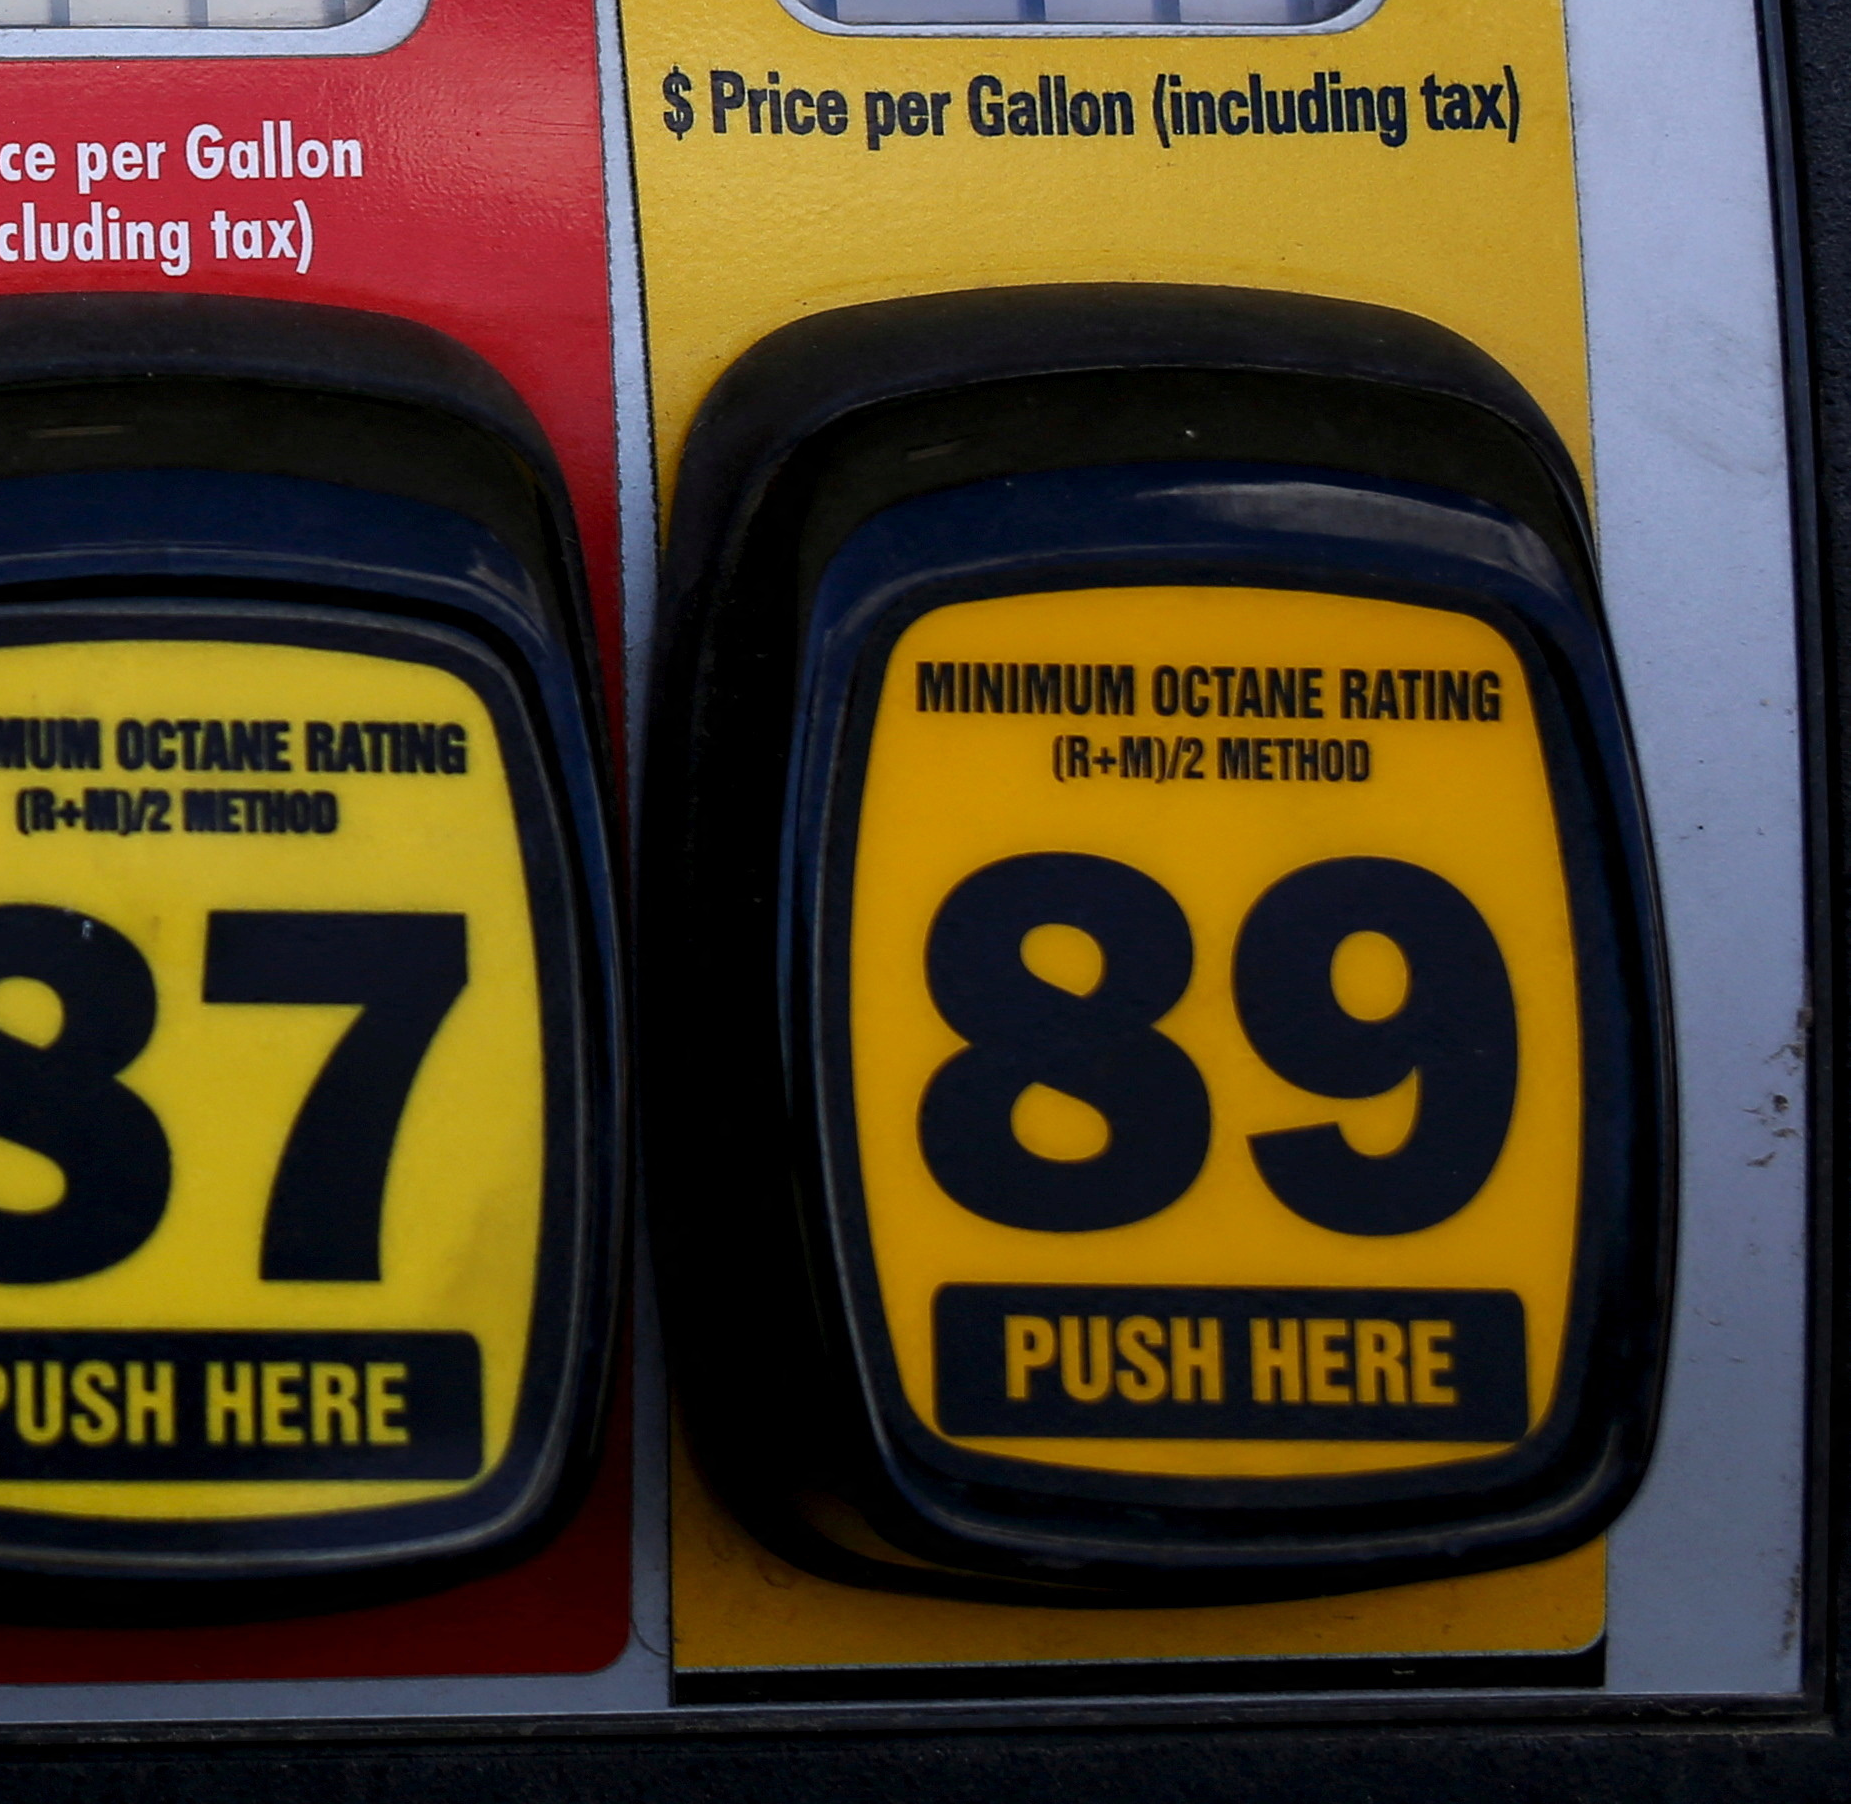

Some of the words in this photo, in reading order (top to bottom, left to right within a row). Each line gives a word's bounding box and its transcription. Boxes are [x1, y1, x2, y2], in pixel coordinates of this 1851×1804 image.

[662, 66, 694, 140] $
[710, 69, 848, 135] Price
[865, 84, 950, 150] per
[966, 74, 1134, 137] Gallon
[1154, 73, 1408, 148] (including
[1421, 66, 1520, 142] tax)
[77, 140, 166, 194] per
[186, 121, 363, 180] Gallon
[211, 201, 313, 275] tax)
[915, 662, 1135, 716] MINIMUM
[1151, 665, 1324, 719] OCTANE
[1339, 669, 1504, 723] RATING
[116, 719, 290, 773] OCTANE
[305, 723, 467, 774] RATING
[1052, 735, 1205, 784] (R+M)/2
[1217, 738, 1371, 783] METHOD
[16, 789, 172, 835] (R+M)/2
[184, 791, 338, 835] METHOD
[917, 850, 1519, 1237] 89
[1004, 1314, 1223, 1403] PUSH
[1249, 1318, 1456, 1406] HERE
[204, 1362, 409, 1445] HERE
